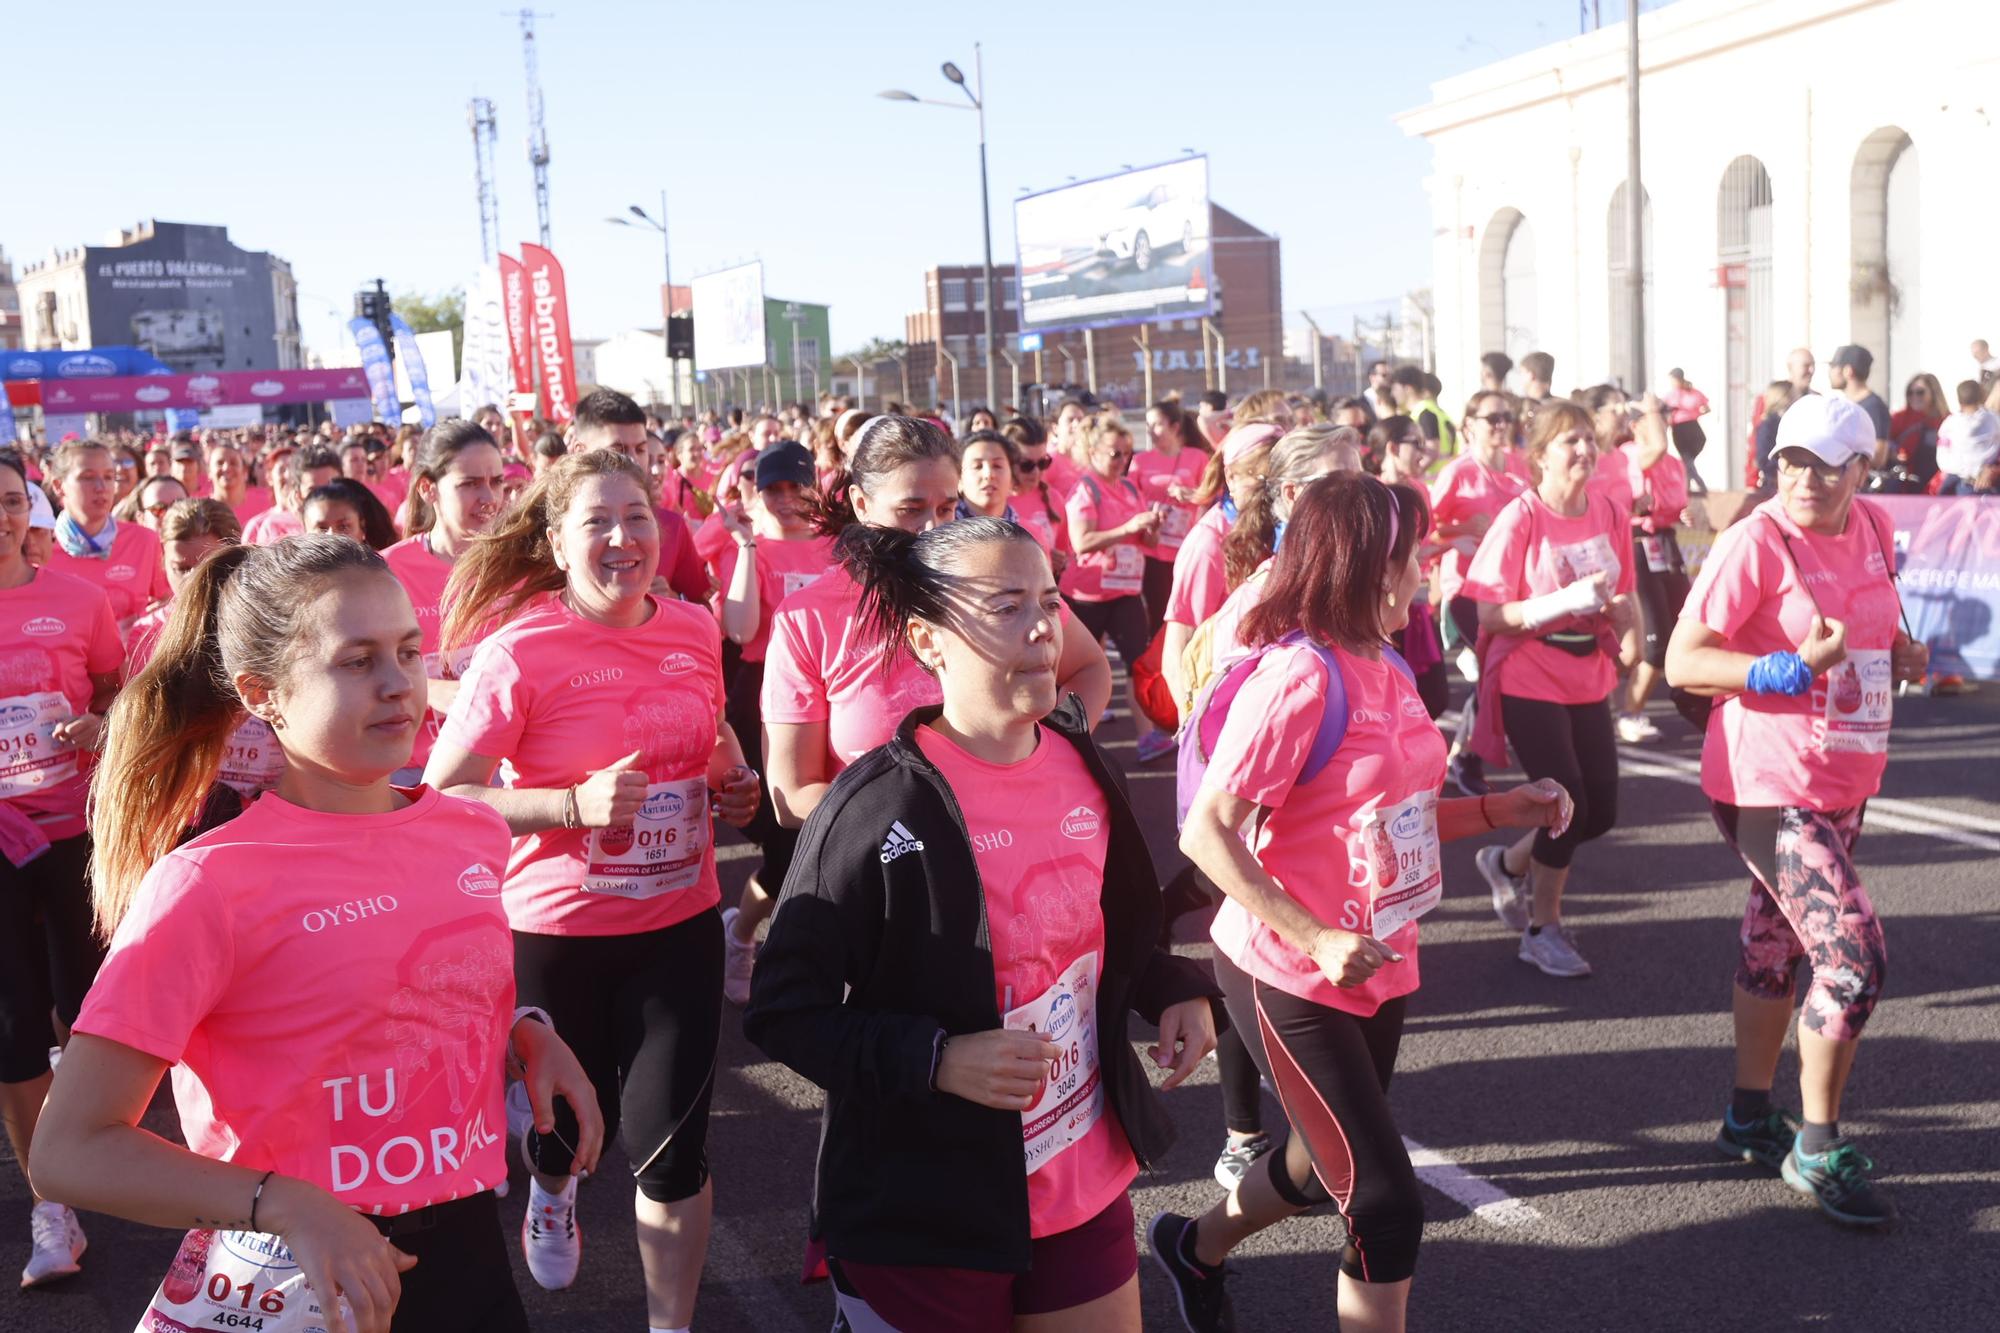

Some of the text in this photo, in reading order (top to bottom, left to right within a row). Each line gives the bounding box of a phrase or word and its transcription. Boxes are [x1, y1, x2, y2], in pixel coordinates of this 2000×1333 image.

[570, 667, 623, 688] OYSHO
[638, 828, 677, 847] 016
[644, 848, 667, 860] 1651
[880, 840, 924, 864] adidas
[603, 865, 640, 875] CARRERA
[596, 881, 639, 891] OYSHO
[303, 894, 398, 932] OYSHO
[1051, 1041, 1079, 1081] 016
[323, 1068, 397, 1121] TU
[1057, 1073, 1076, 1099] 3049
[1023, 1113, 1055, 1138] CARRERA
[207, 1272, 286, 1313] 016
[213, 1312, 264, 1333] 4644
